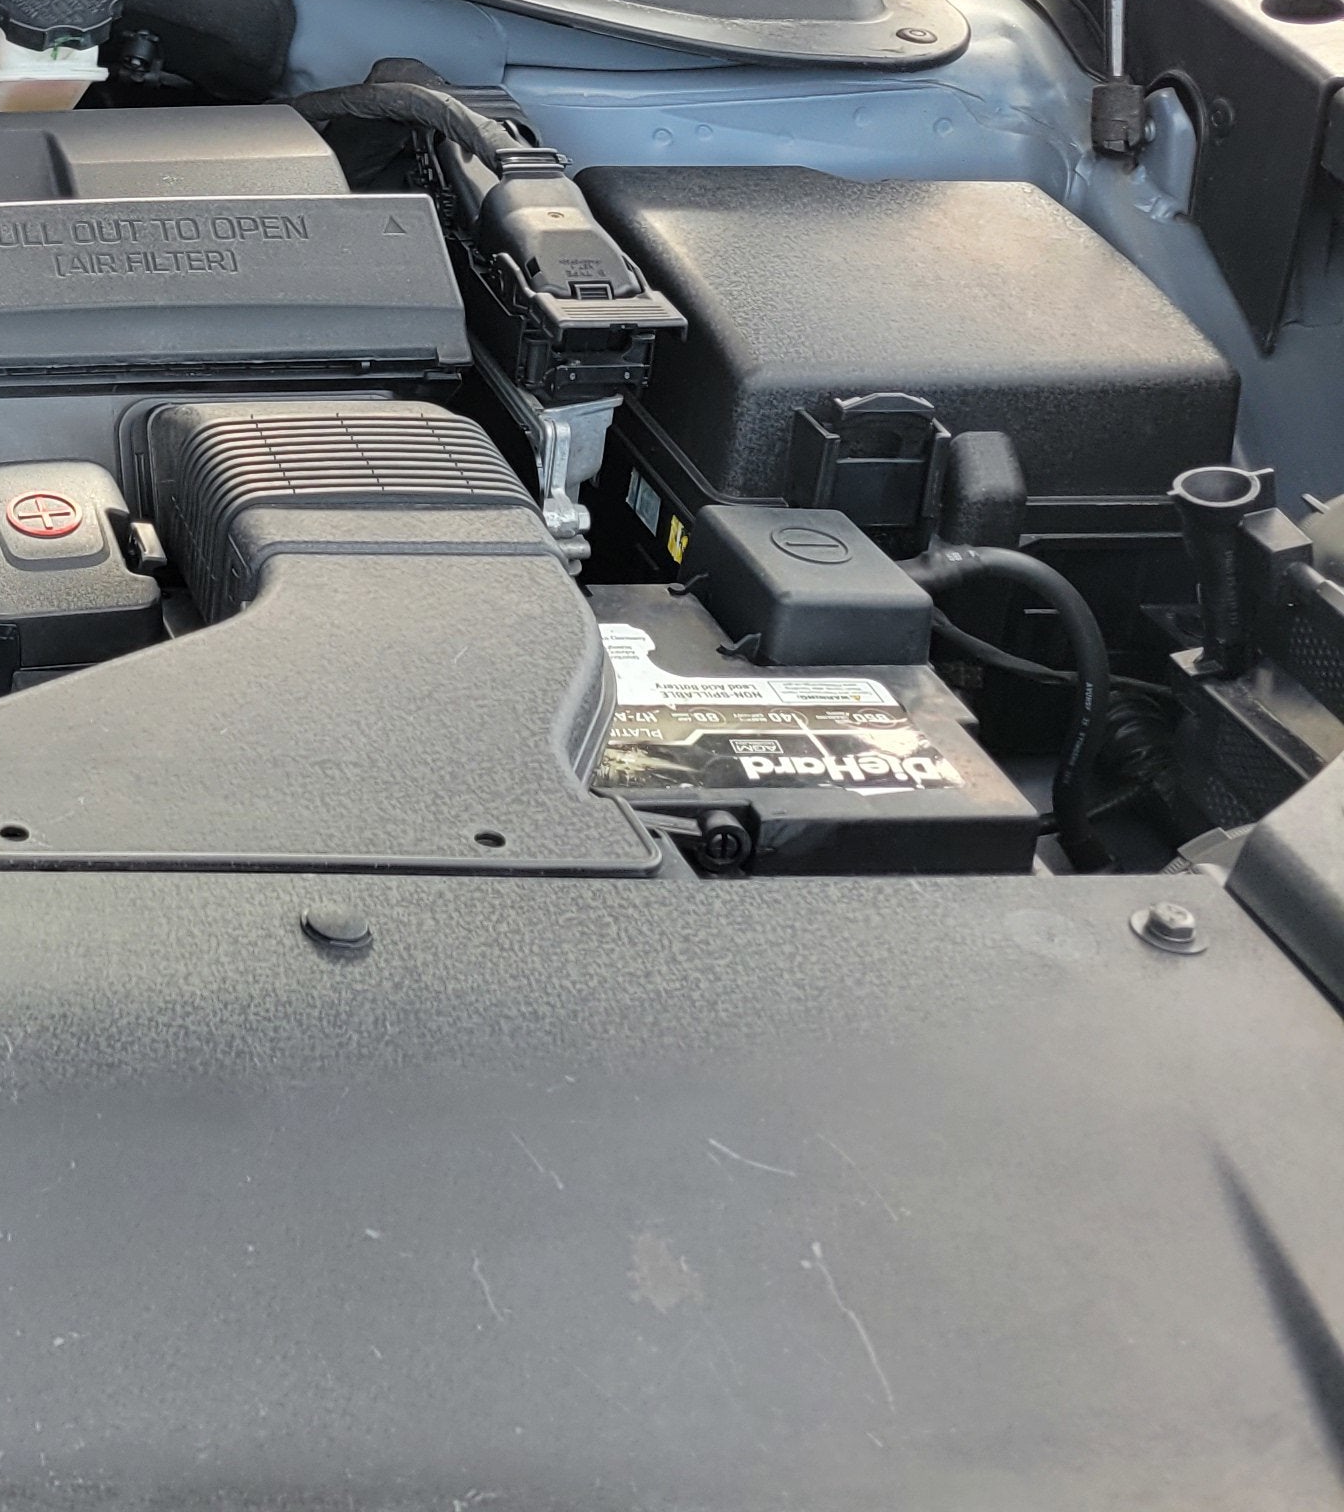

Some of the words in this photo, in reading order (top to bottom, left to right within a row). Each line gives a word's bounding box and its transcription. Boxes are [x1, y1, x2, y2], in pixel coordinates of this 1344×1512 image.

[71, 218, 146, 245] OUT
[151, 216, 201, 243] TO
[210, 214, 311, 241] OPEN
[701, 683, 725, 691] Acid
[659, 690, 763, 699] NON-SPILLABLE
[614, 711, 658, 723] H7-A
[736, 743, 779, 752] AGM
[740, 755, 935, 784] DieHard
